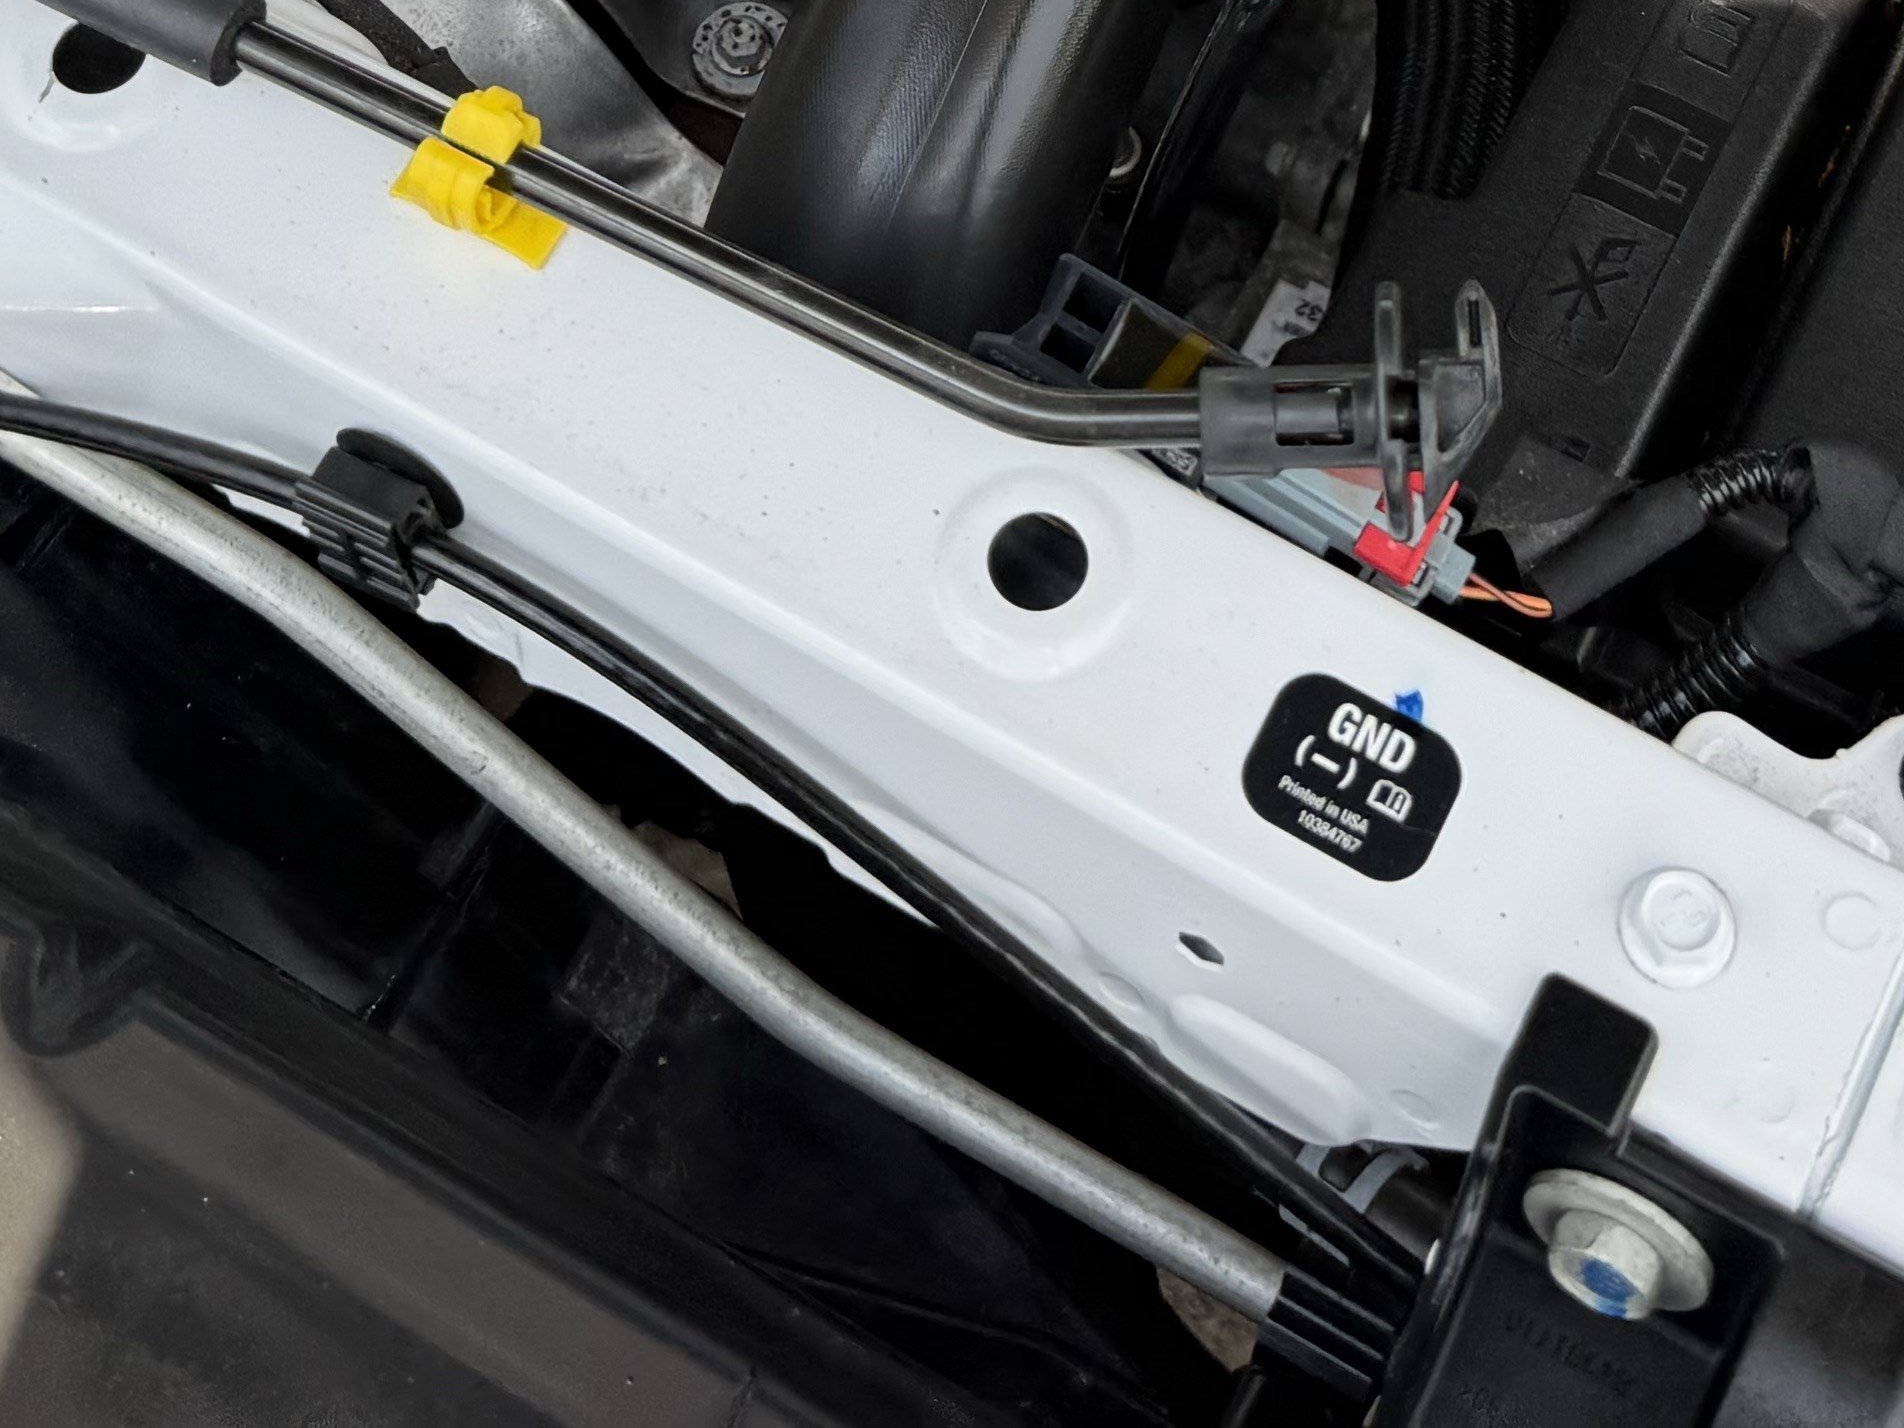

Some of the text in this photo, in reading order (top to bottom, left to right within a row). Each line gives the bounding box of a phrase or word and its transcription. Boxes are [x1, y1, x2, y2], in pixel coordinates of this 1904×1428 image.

[1327, 702, 1416, 774] GND
[1277, 774, 1327, 811] Printed
[1339, 808, 1371, 838] USA
